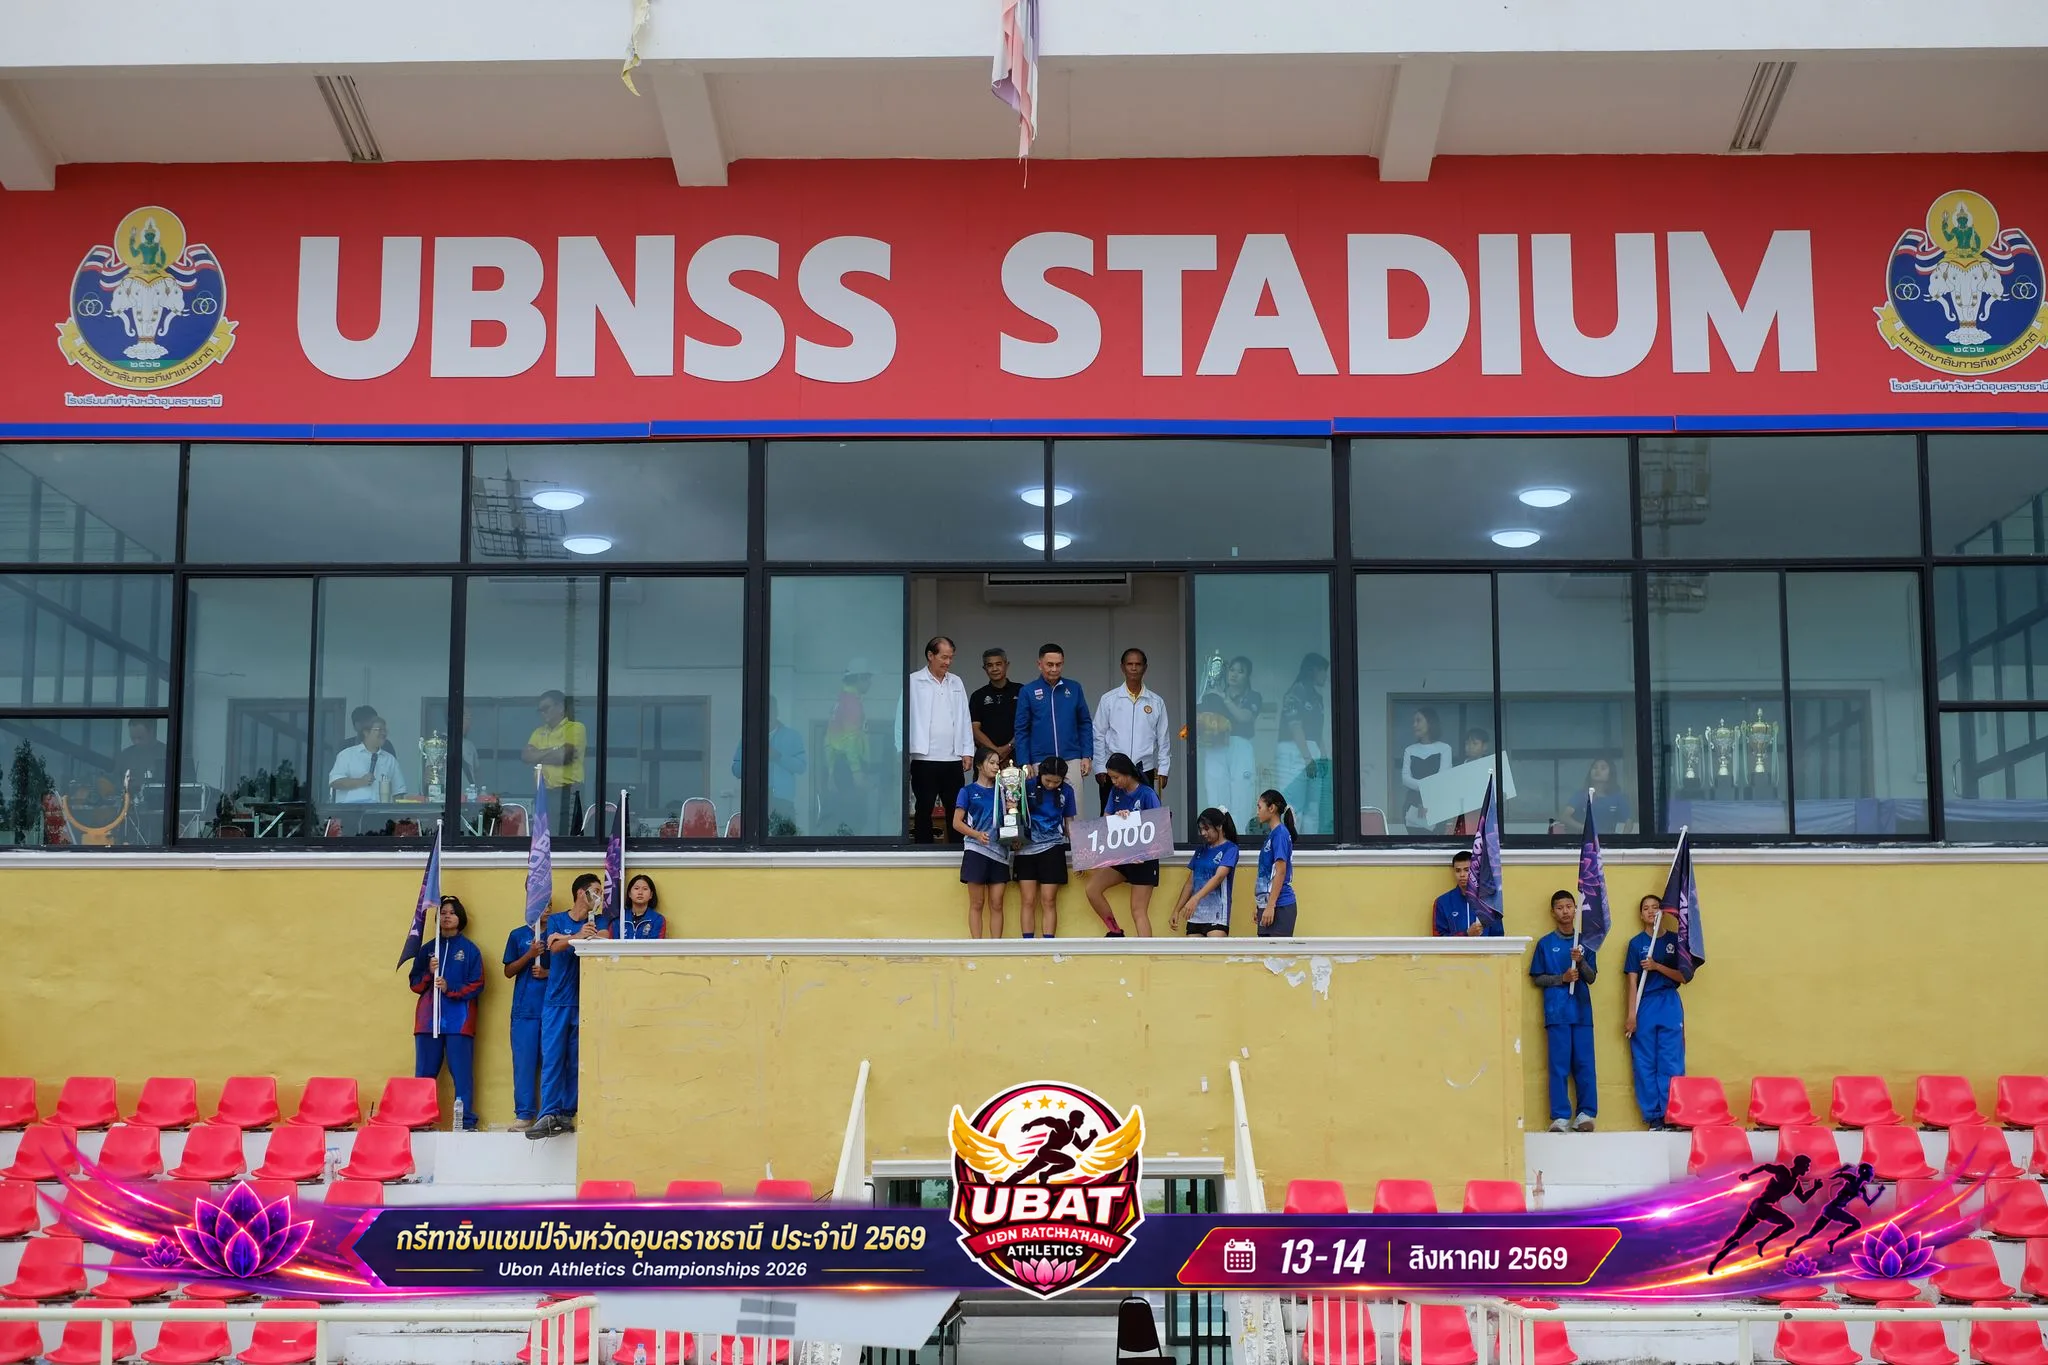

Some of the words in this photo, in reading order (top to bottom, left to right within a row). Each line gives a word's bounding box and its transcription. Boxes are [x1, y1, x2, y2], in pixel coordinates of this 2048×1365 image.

[297, 234, 897, 383] UBNSS
[1000, 229, 1818, 379] STADIUM
[78, 346, 215, 384] มหาวิทยาลัยการกีฬาแห่งชาติ
[1898, 331, 2039, 369] มหาวิทยาลัยการกีฬาแห่งชาติ
[1087, 821, 1156, 854] 1,000
